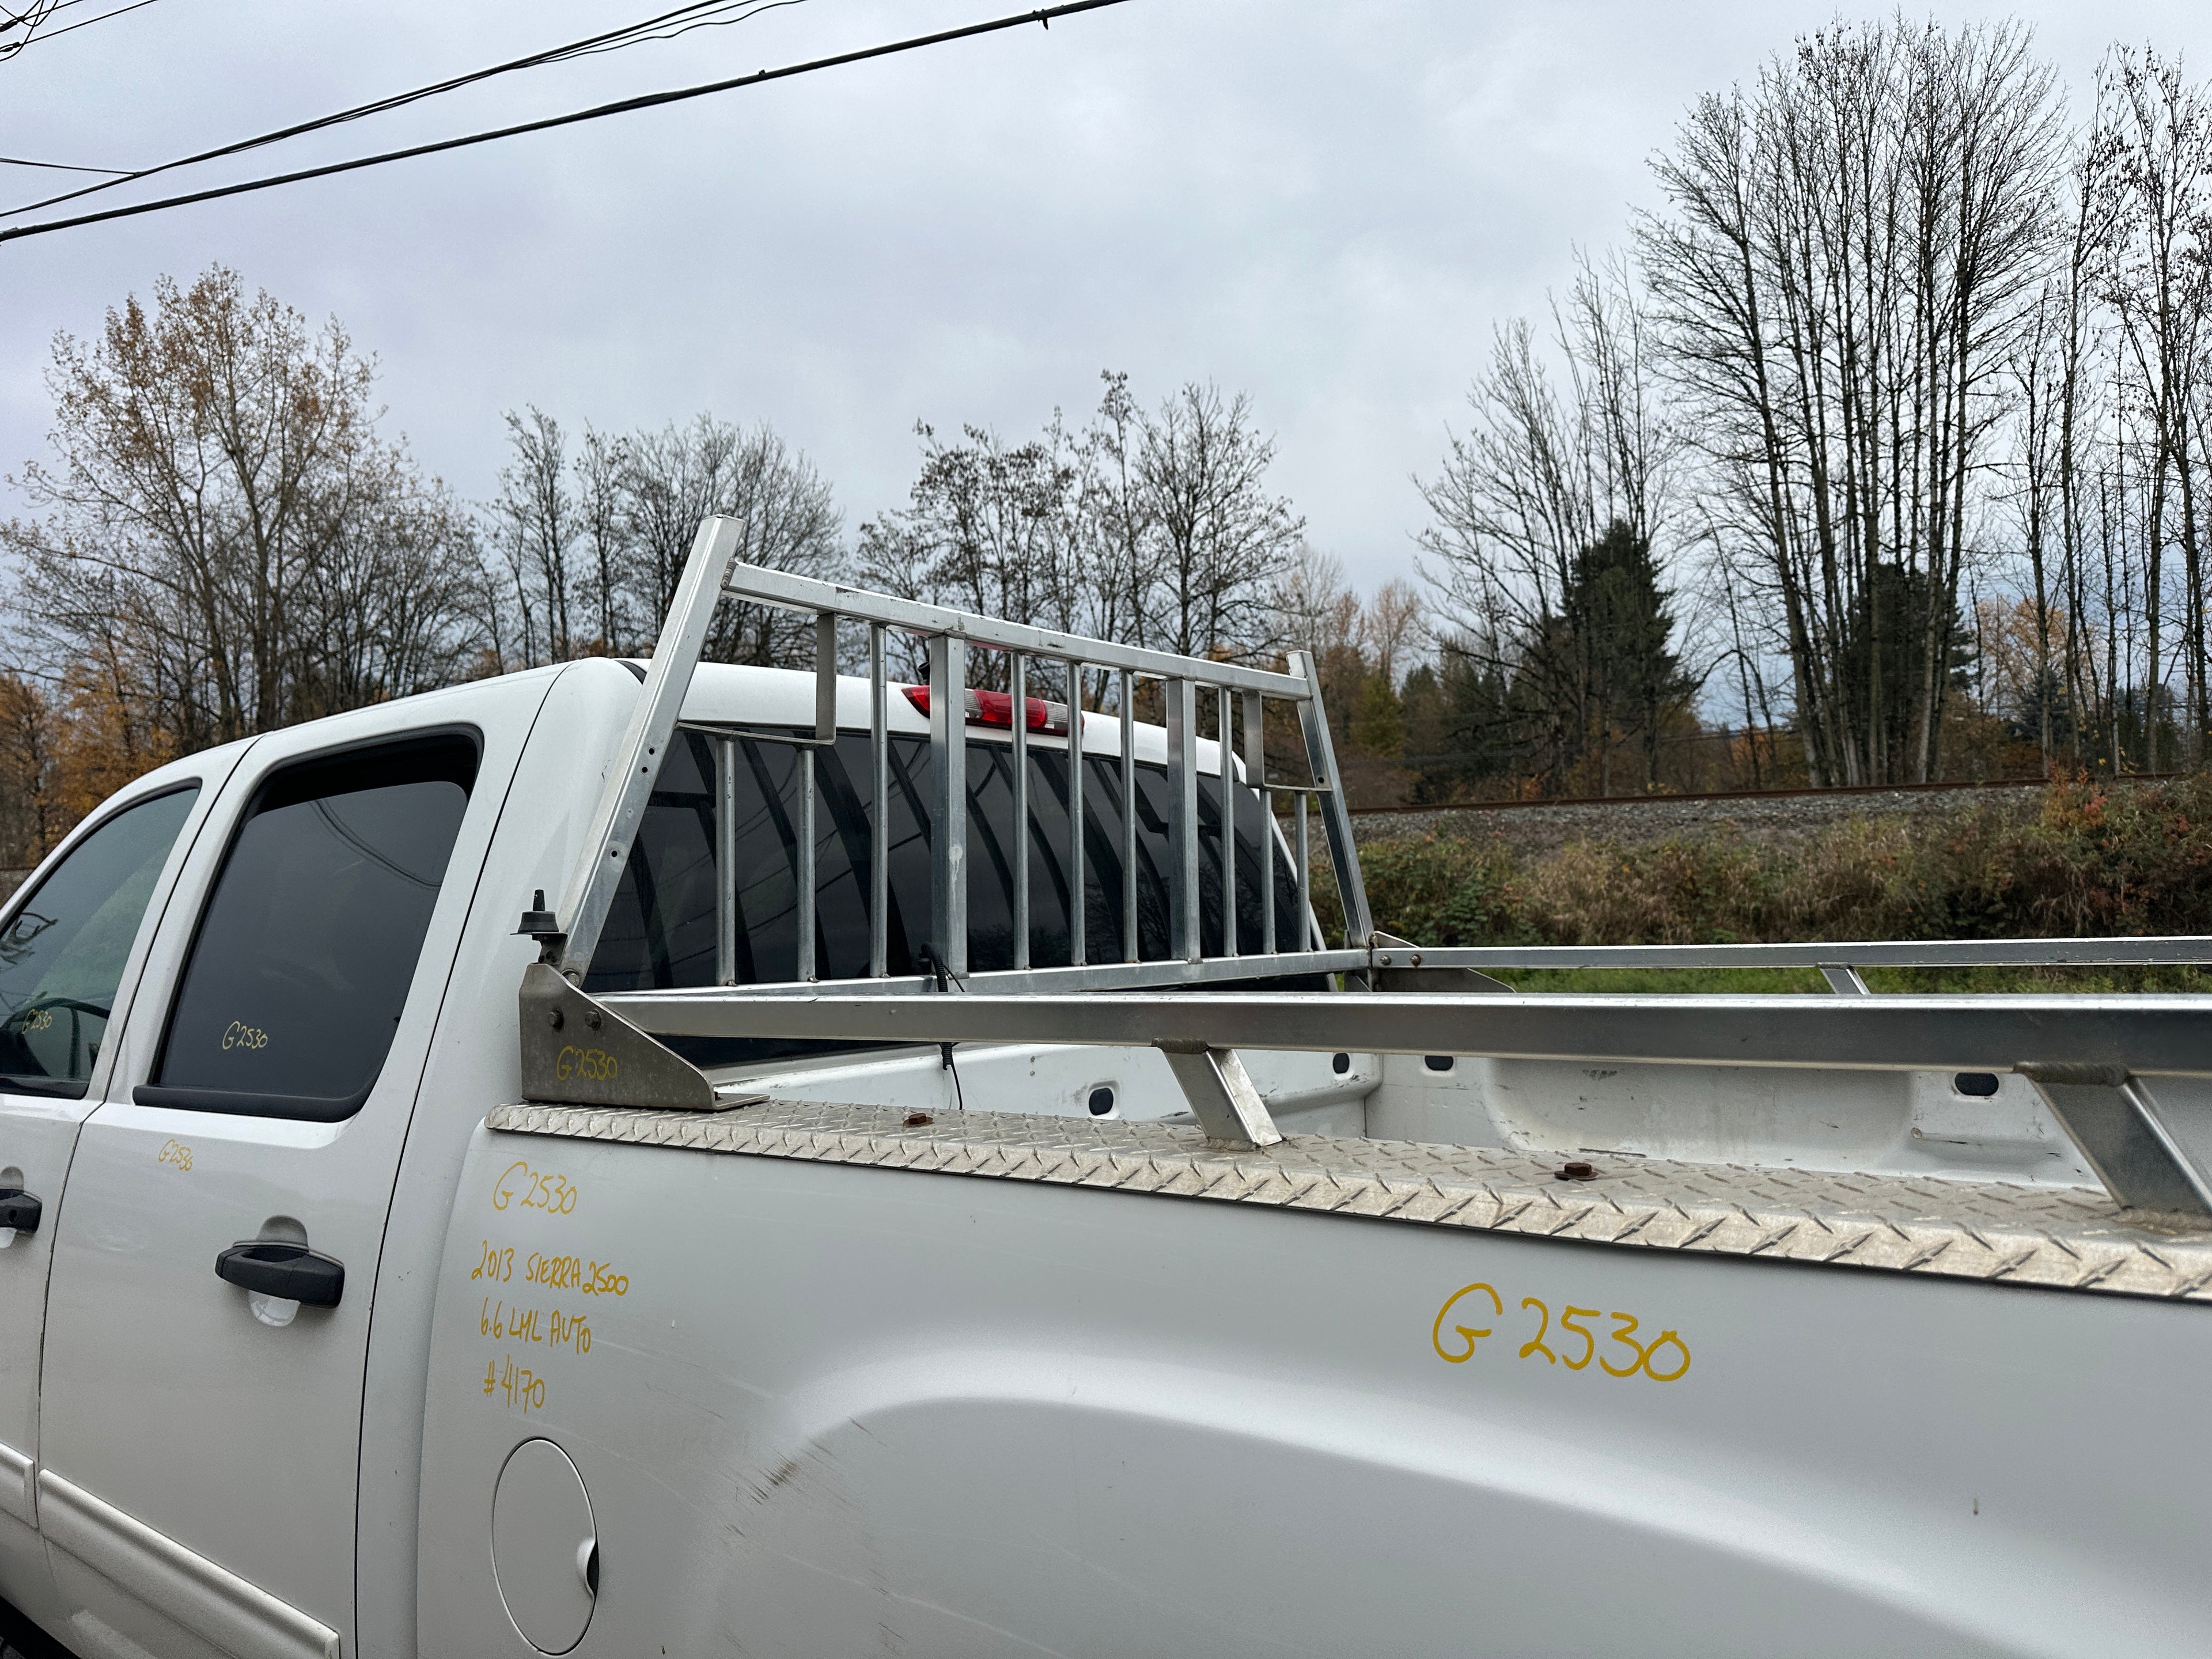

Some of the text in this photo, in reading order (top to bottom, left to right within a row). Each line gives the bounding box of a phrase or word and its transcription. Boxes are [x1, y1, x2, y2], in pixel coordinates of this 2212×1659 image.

[222, 1021, 268, 1050] G2530
[556, 1045, 618, 1081] G2530
[471, 1240, 629, 1296] 2013 SIERRA 2500
[480, 1297, 592, 1354] 6.6 LML AUTO
[483, 1354, 545, 1413] #4170
